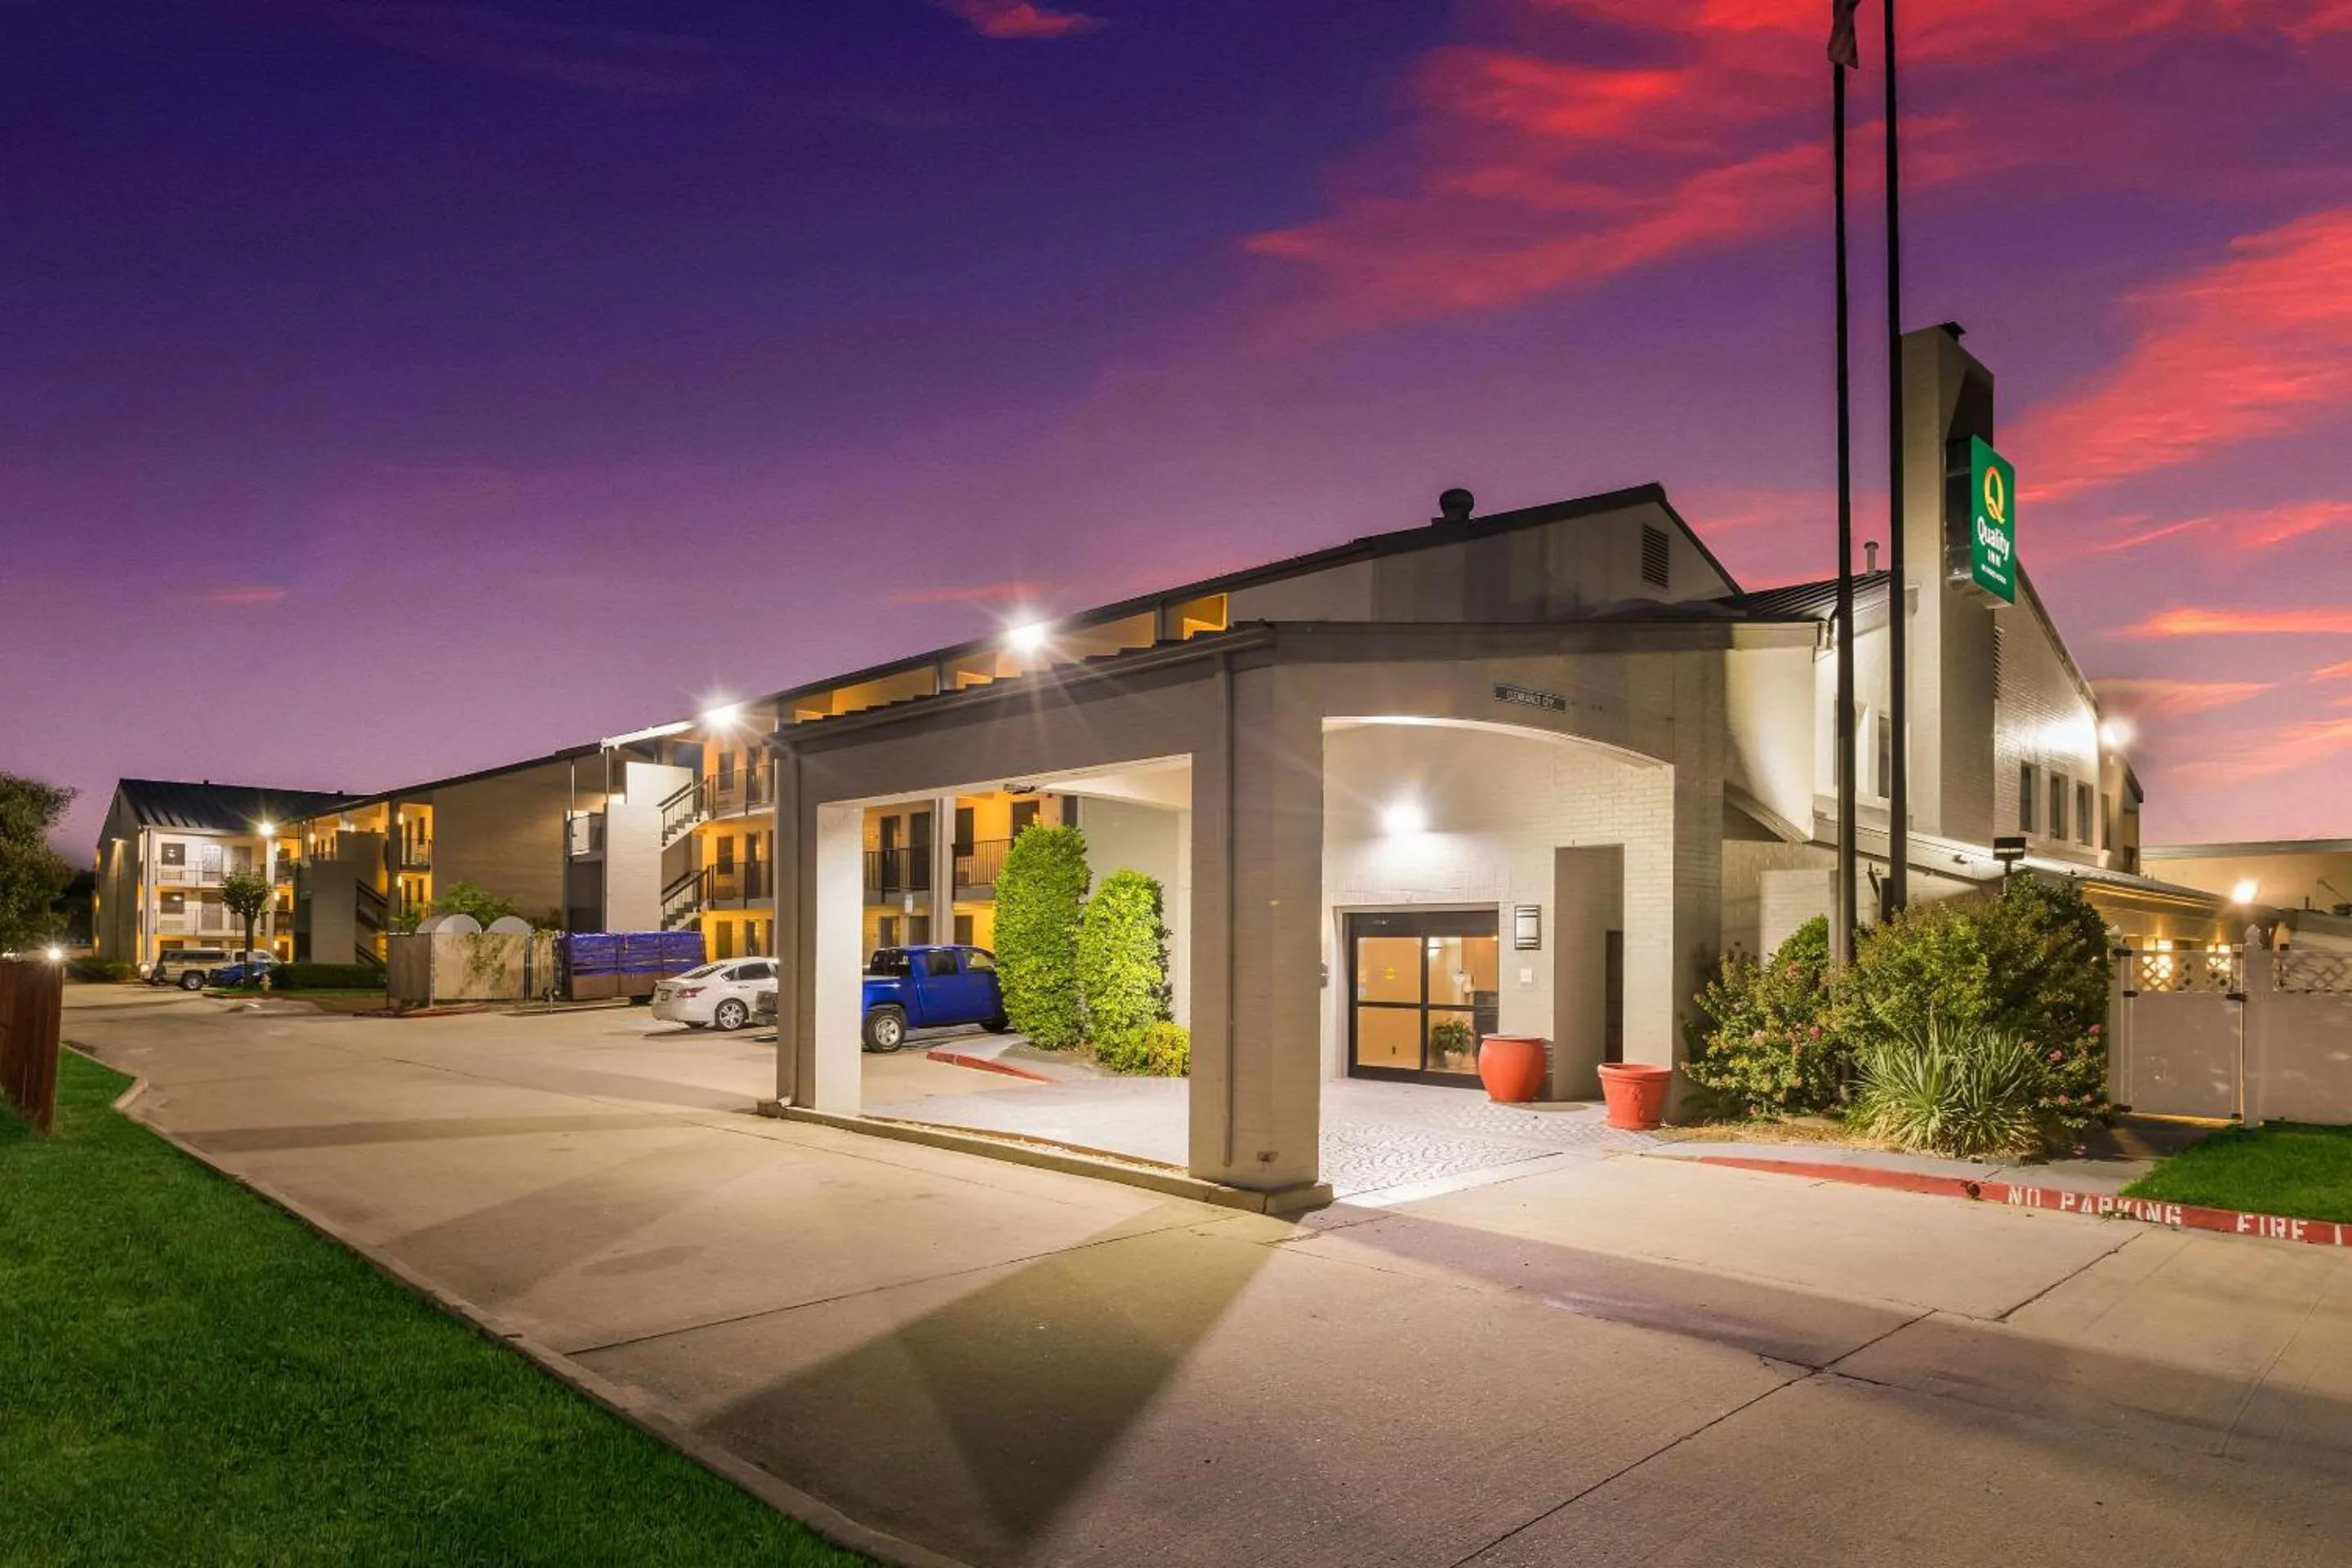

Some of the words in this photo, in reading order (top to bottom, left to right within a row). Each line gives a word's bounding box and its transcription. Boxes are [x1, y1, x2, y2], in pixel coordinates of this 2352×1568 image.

[1984, 466, 2005, 524] Q
[1977, 515, 2010, 562] Quality
[2008, 1184, 2042, 1207] NO
[2060, 1191, 2182, 1225] PARKING
[2237, 1213, 2309, 1241] FIRE
